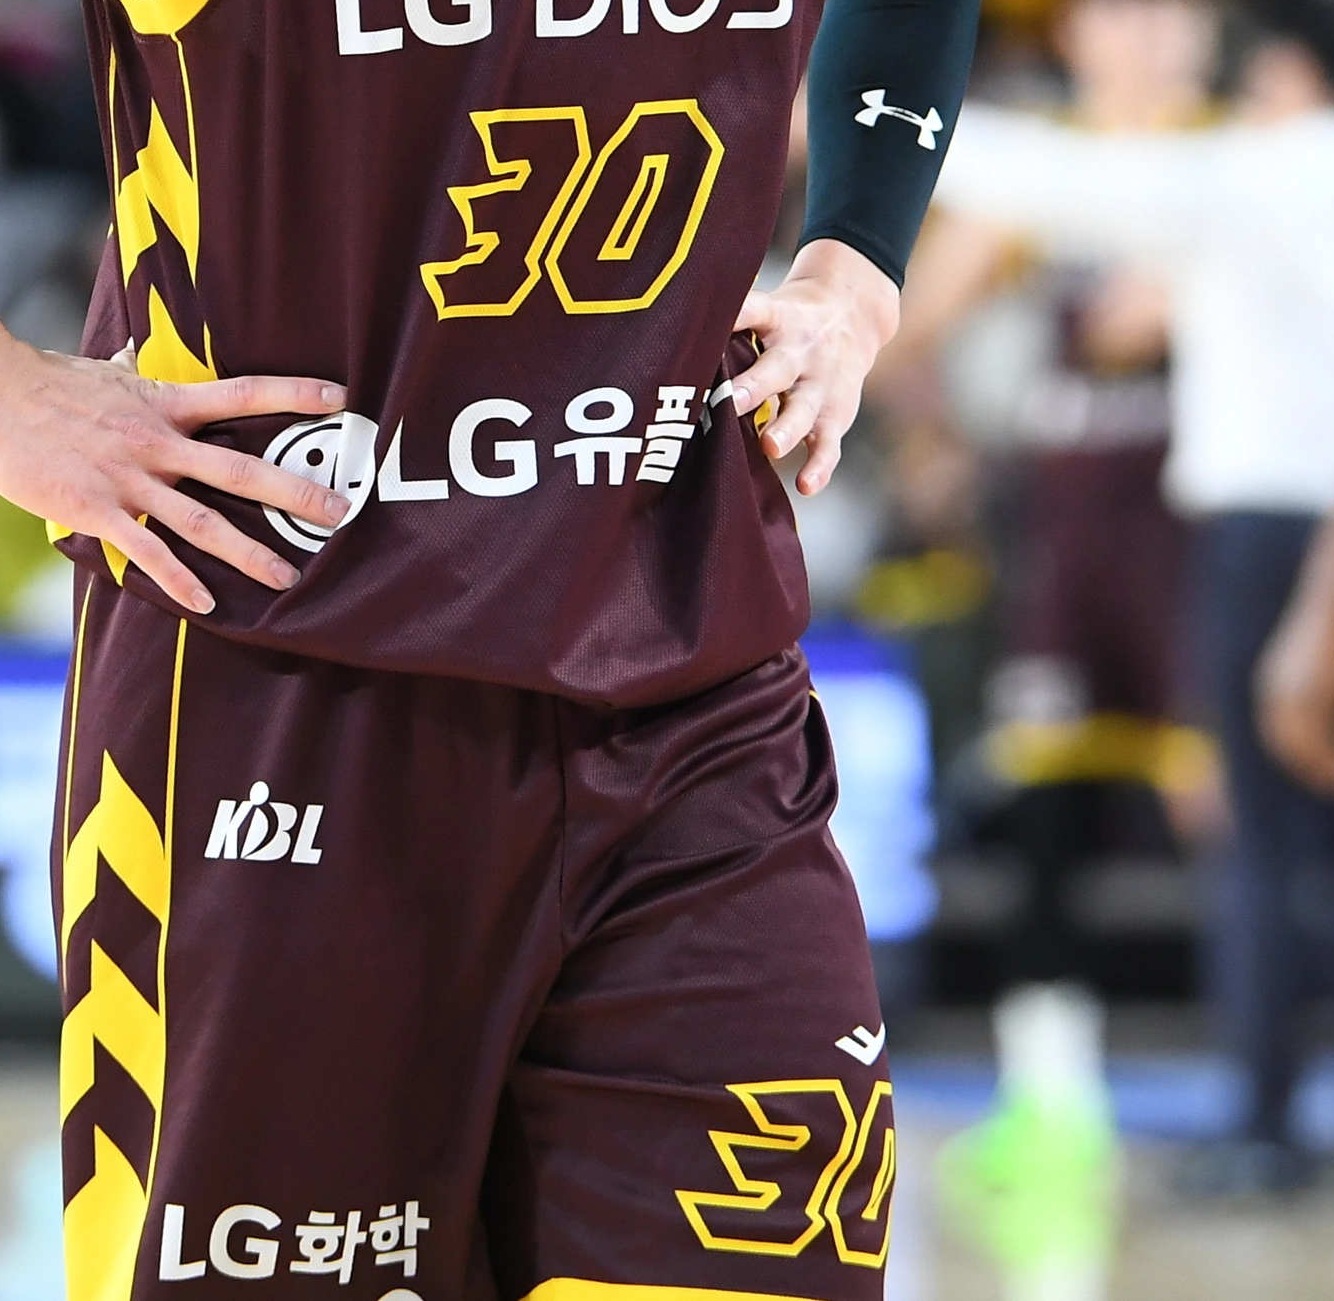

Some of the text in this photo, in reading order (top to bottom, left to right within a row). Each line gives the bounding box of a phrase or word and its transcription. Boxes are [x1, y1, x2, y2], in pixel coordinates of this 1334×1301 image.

[420, 98, 725, 322] 30
[378, 398, 538, 502] LG
[203, 781, 324, 865] KBL
[674, 1078, 897, 1270] 30
[158, 1200, 430, 1285] LG 화학
